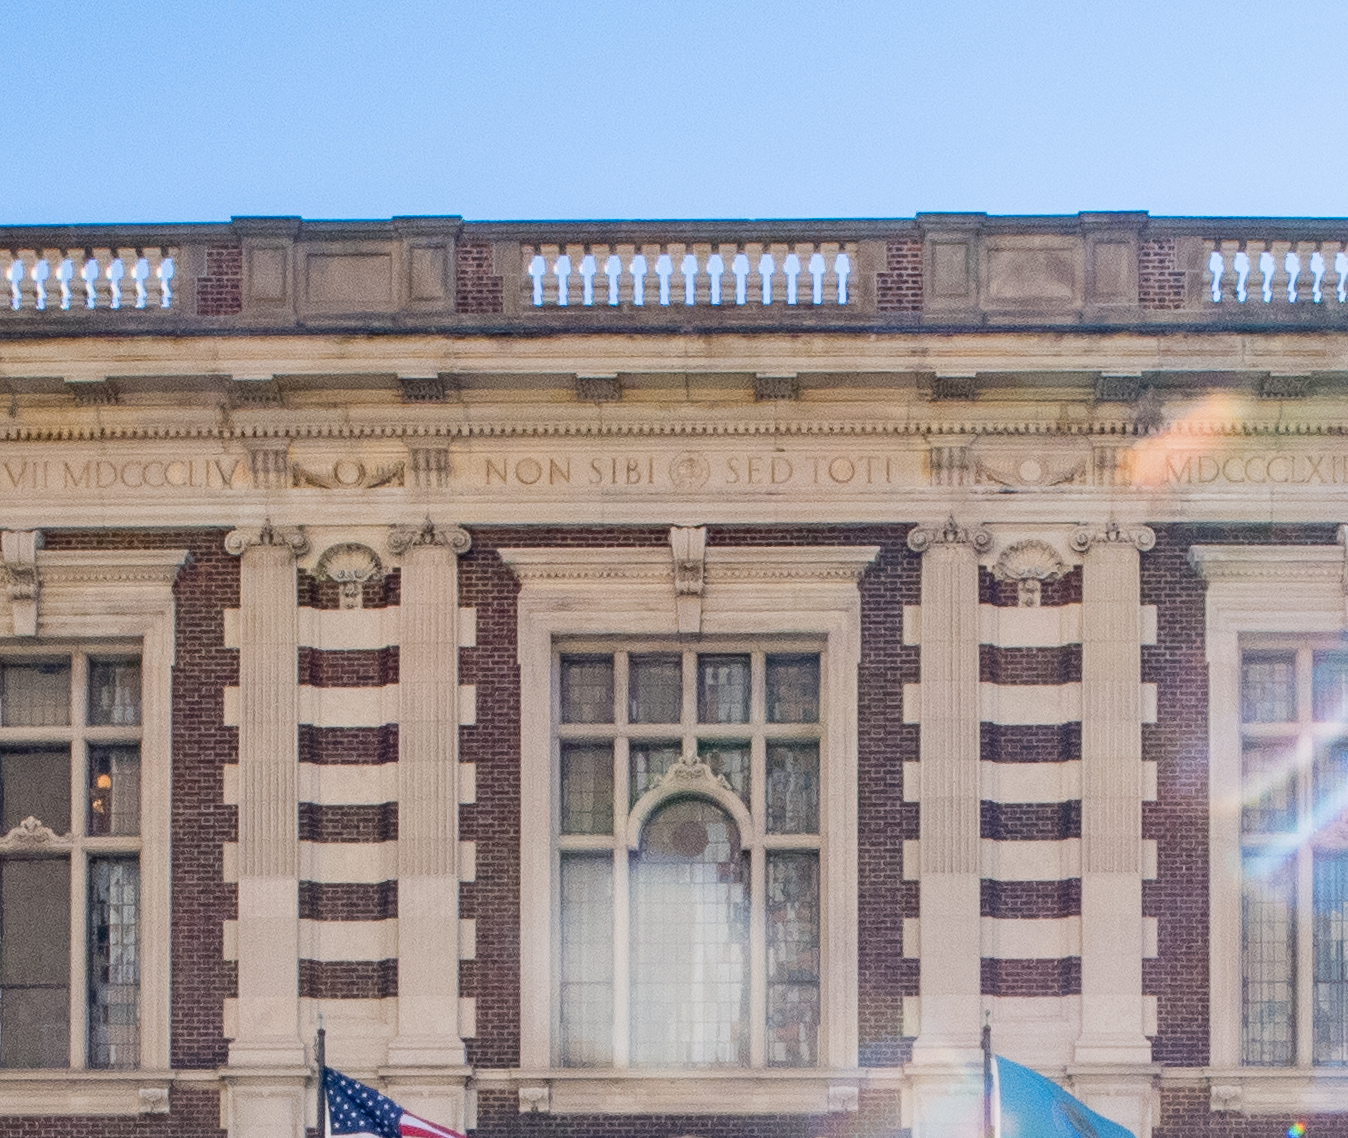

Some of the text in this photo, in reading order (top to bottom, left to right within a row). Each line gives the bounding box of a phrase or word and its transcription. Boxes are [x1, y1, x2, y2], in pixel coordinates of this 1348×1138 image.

[63, 459, 239, 490] MDCCCLIV
[485, 457, 893, 485] NON SIBI SED TOTI
